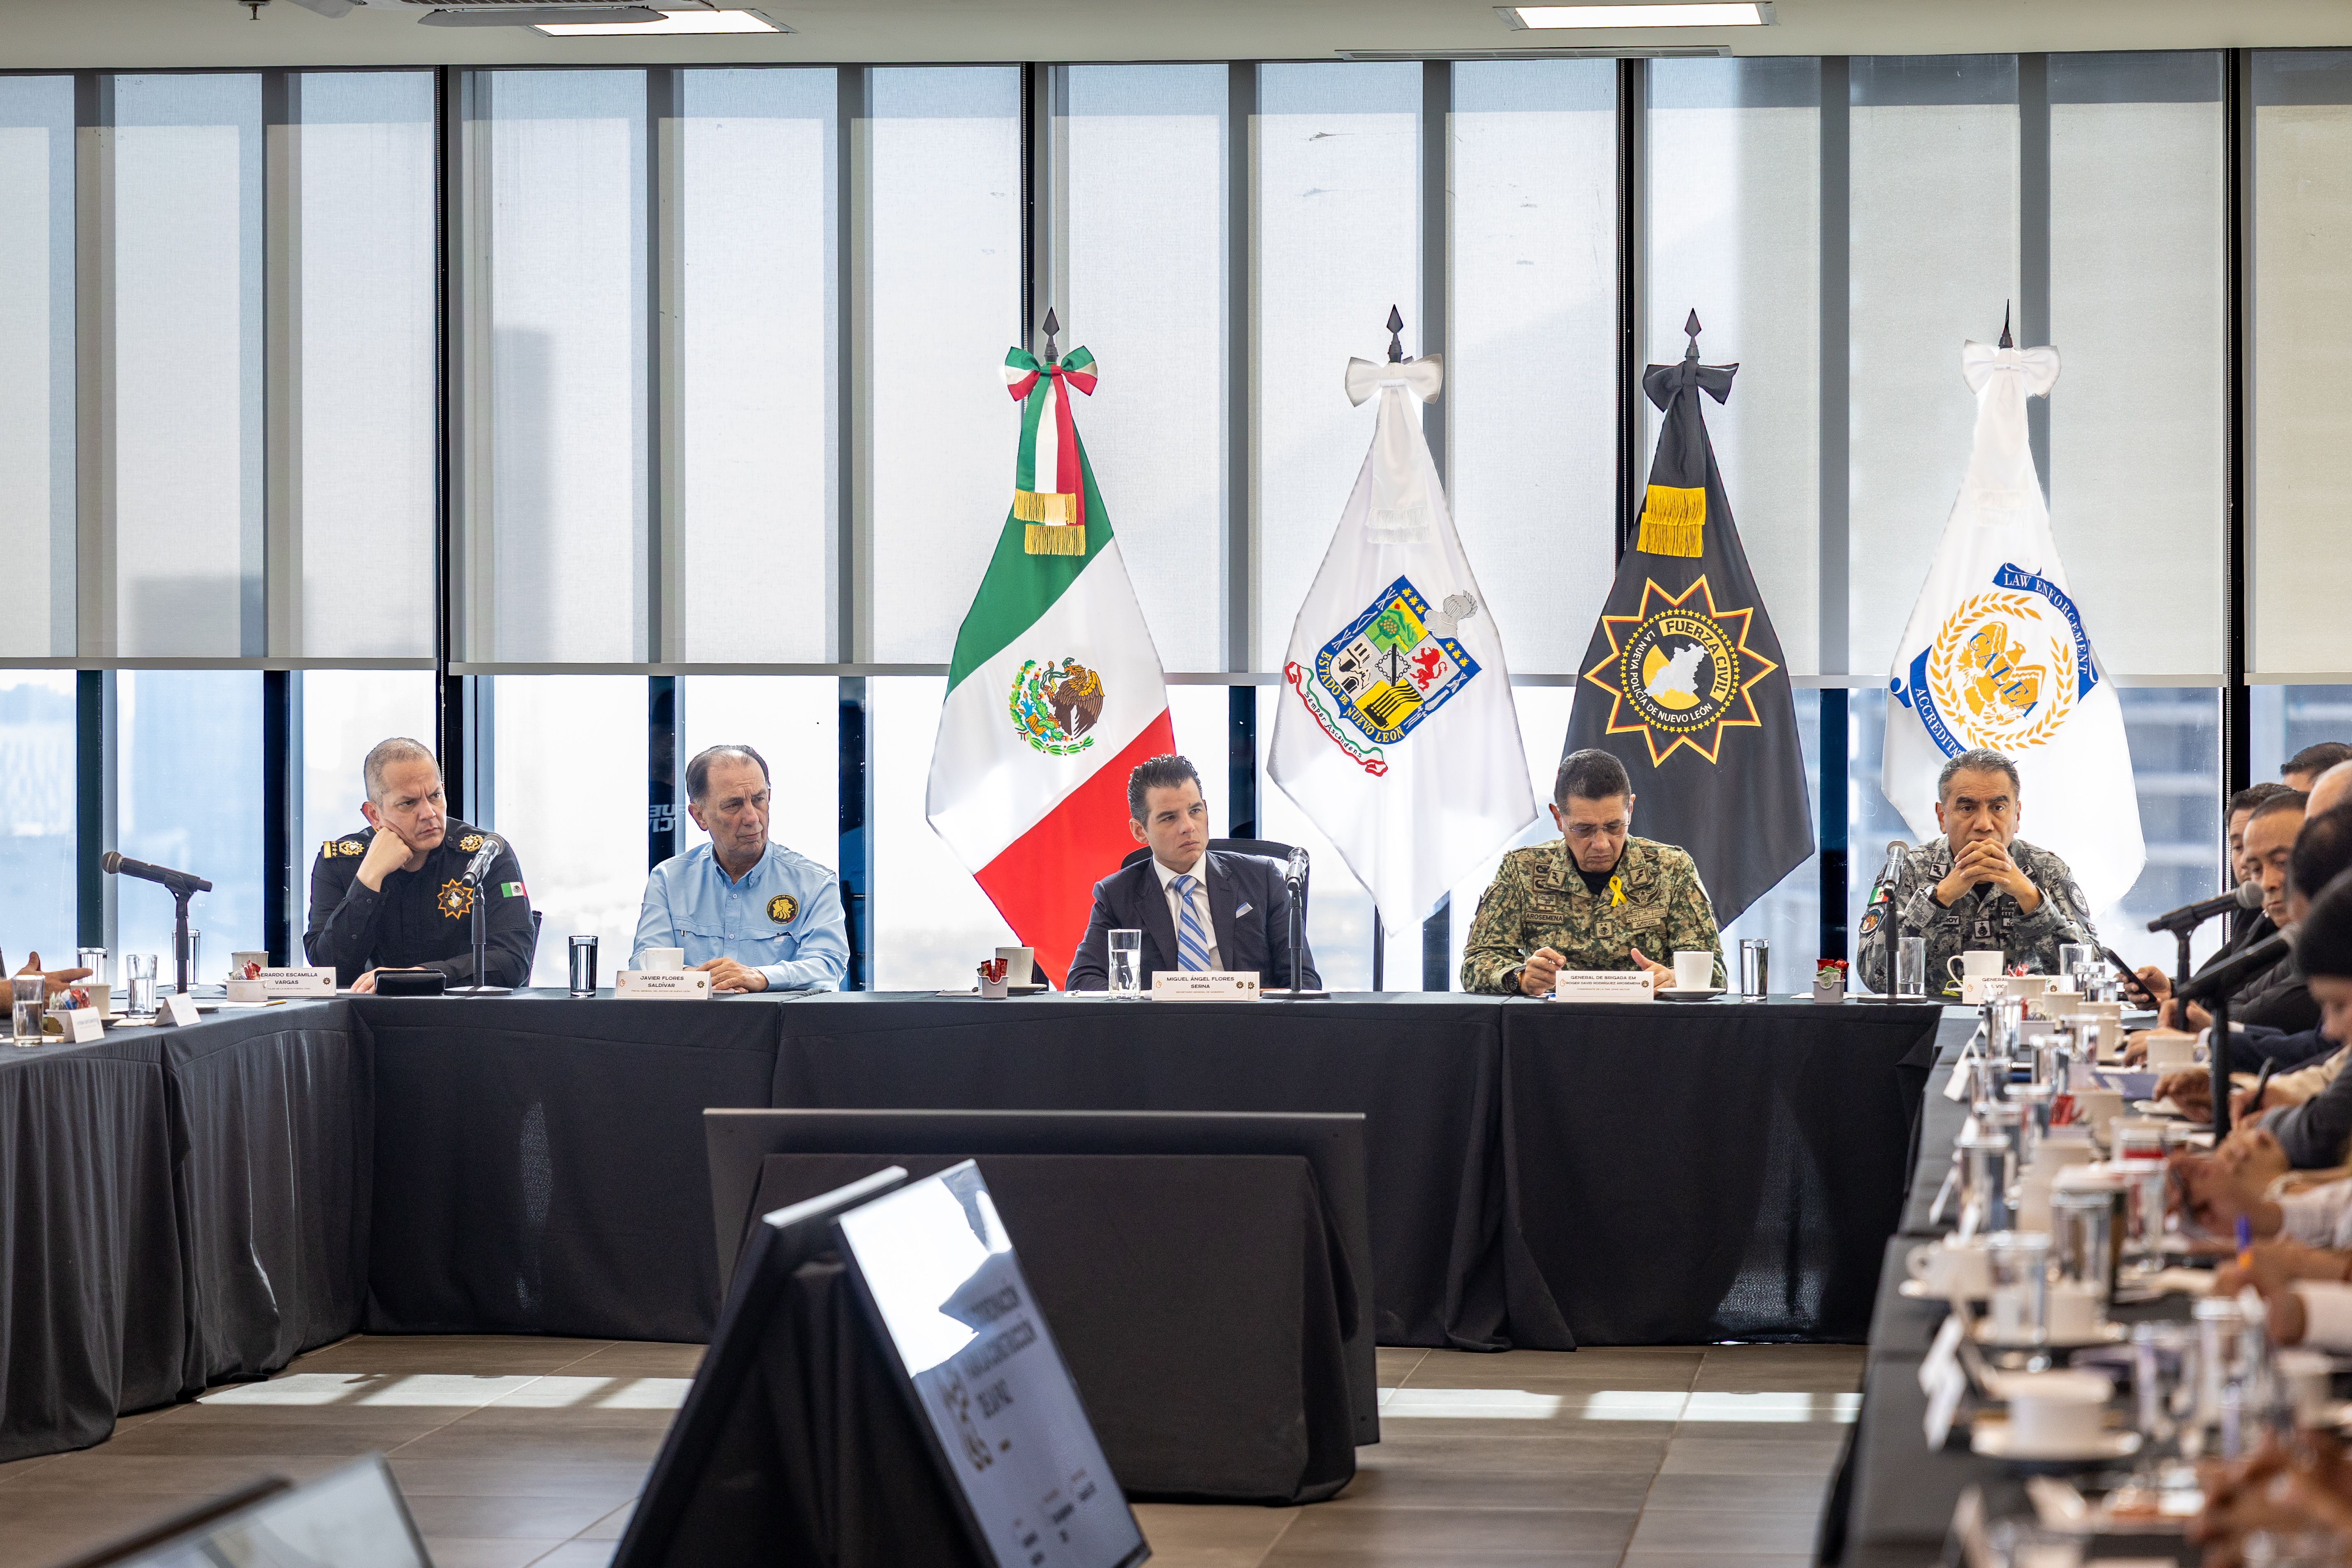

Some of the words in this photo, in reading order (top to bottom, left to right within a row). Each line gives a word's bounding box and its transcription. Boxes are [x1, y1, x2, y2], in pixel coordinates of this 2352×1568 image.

[1645, 630, 1655, 643] LA
[2004, 573, 2031, 586] LAW
[2035, 579, 2089, 674] ENFORCEMENT
[1630, 641, 1647, 670] NUEVA
[1666, 621, 1720, 655] FUERZA
[1714, 656, 1728, 693] CIVIL
[1630, 672, 1648, 706] POLICÍA
[1969, 632, 2038, 720] CALEA
[1318, 651, 1339, 696] ESTADO
[1339, 693, 1349, 705] DE
[1345, 707, 1375, 735] NUEVO
[1375, 726, 1406, 743] LEON
[1646, 705, 1658, 716] DE
[1690, 703, 1713, 721] LEÓN
[1304, 692, 1326, 722] Semper
[1324, 724, 1363, 758] Ascendens
[1658, 711, 1689, 723] NUEVO
